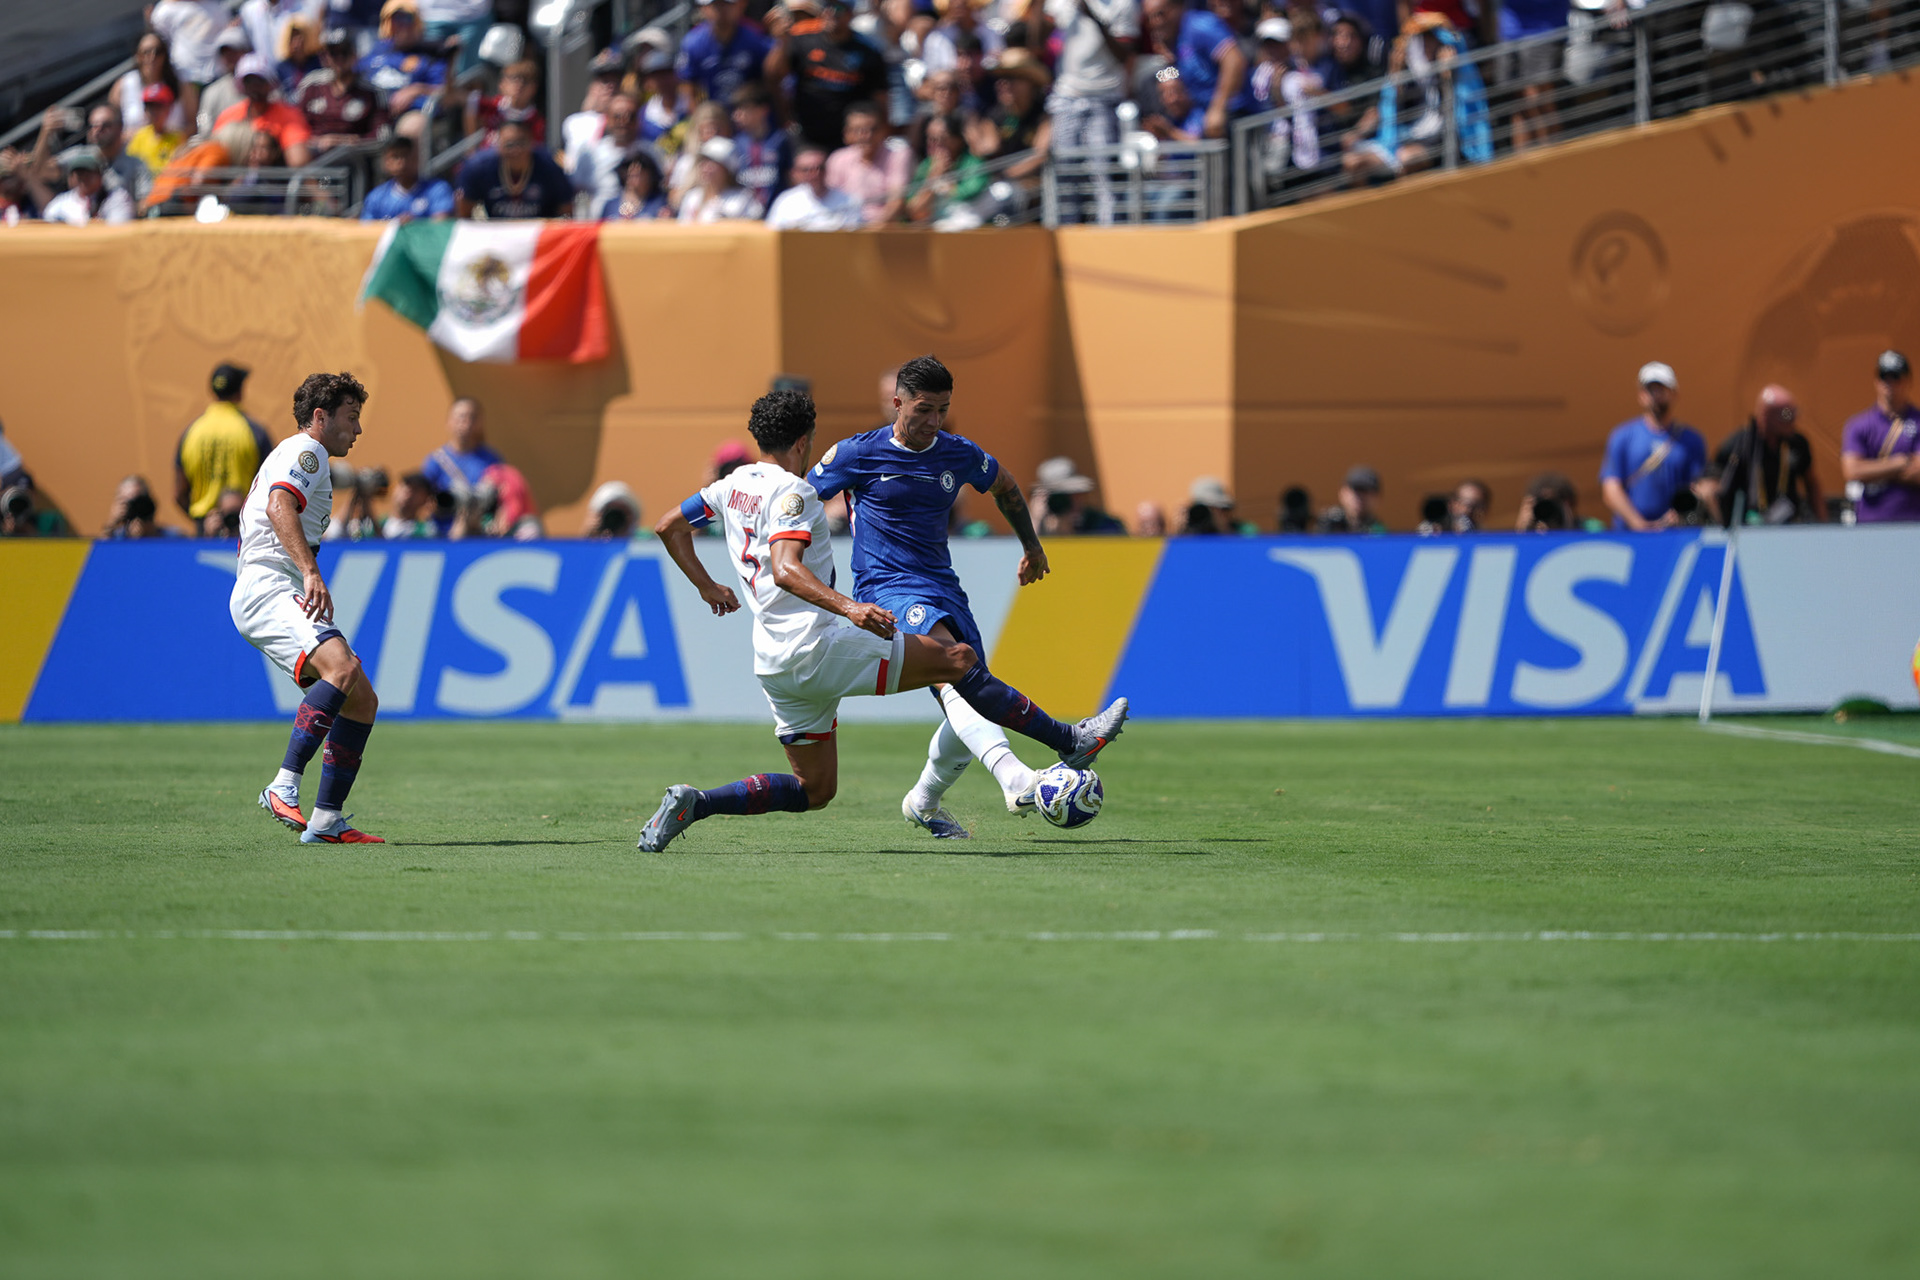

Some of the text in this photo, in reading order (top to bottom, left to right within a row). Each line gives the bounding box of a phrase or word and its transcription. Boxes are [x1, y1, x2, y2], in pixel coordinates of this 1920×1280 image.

[197, 548, 695, 714] VISA
[741, 526, 762, 599] 5
[1268, 540, 1770, 710] VISA
